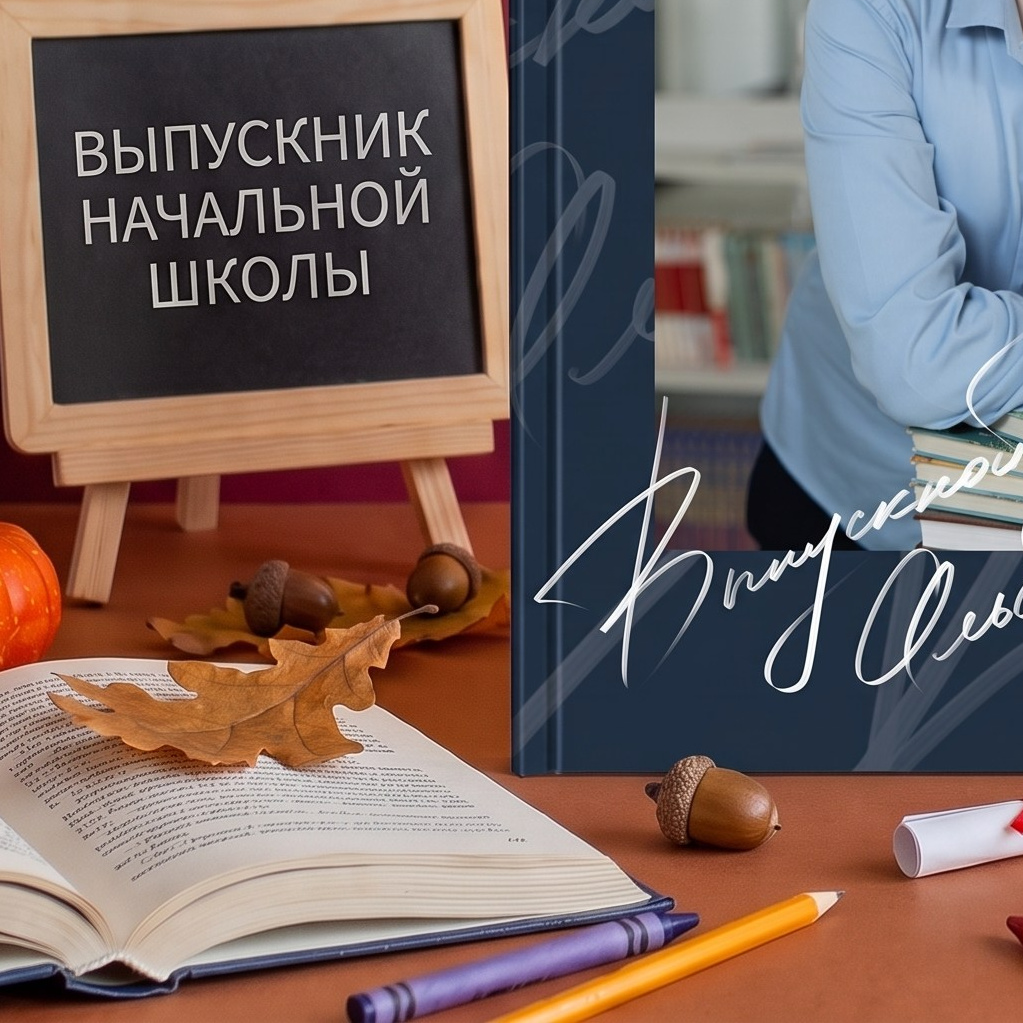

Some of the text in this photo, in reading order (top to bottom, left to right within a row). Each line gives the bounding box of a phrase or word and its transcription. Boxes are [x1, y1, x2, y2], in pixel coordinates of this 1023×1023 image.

[74, 108, 433, 178] ВЫПУСКНИК
[82, 165, 430, 245] НАЧАЛЬНОЙ
[149, 249, 371, 309] ШКОЛЫ
